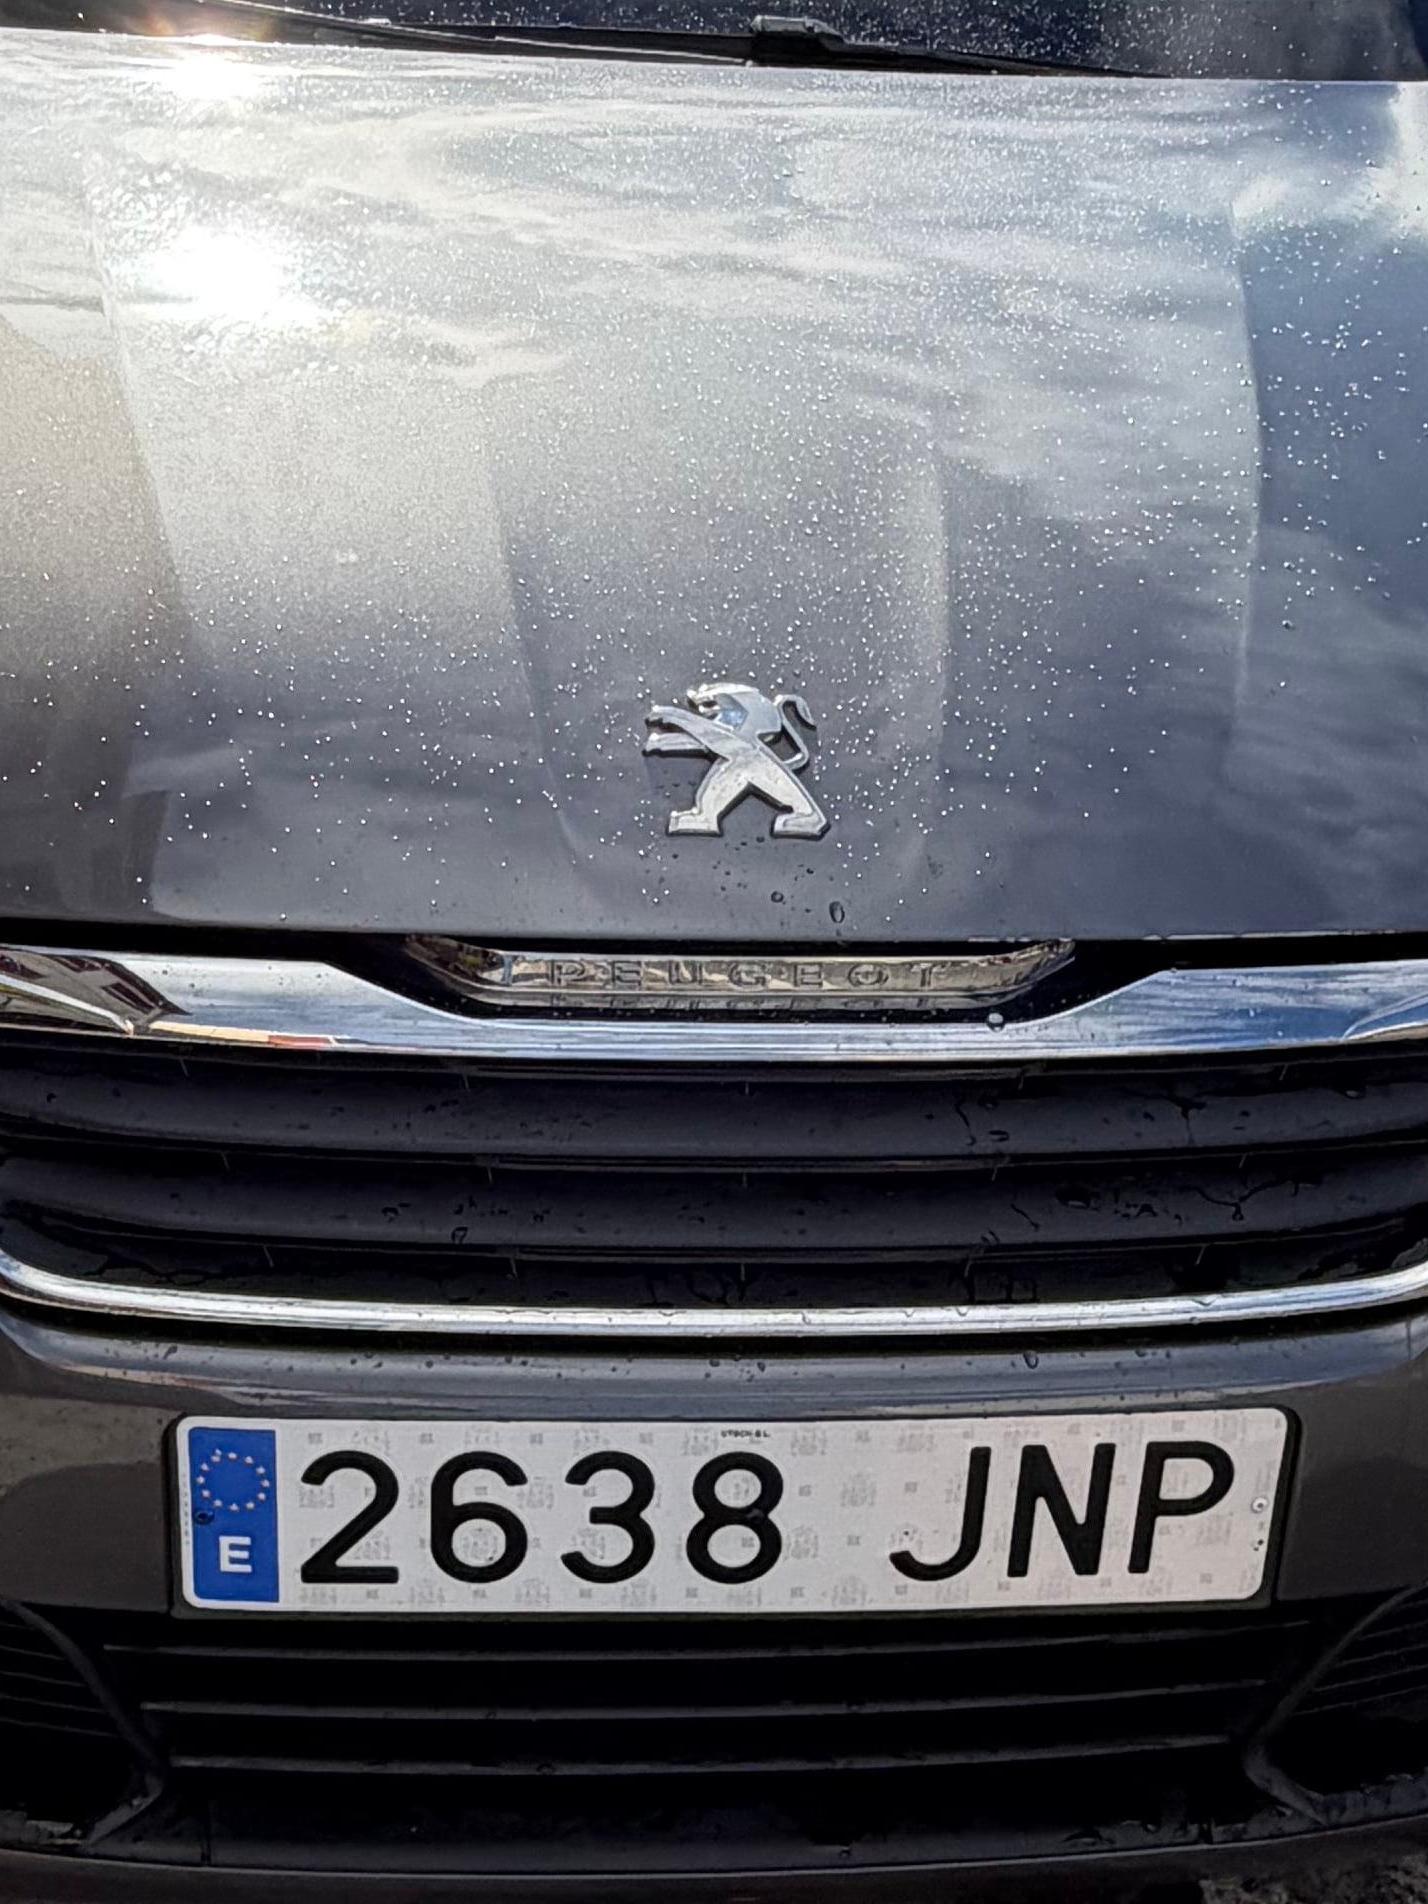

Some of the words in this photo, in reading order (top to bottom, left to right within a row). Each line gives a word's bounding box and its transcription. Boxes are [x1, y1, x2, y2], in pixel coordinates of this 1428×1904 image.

[549, 959, 943, 989] PEUGEOT
[299, 1449, 785, 1585] 2638
[888, 1441, 1236, 1582] JNP
[219, 1535, 252, 1573] E
